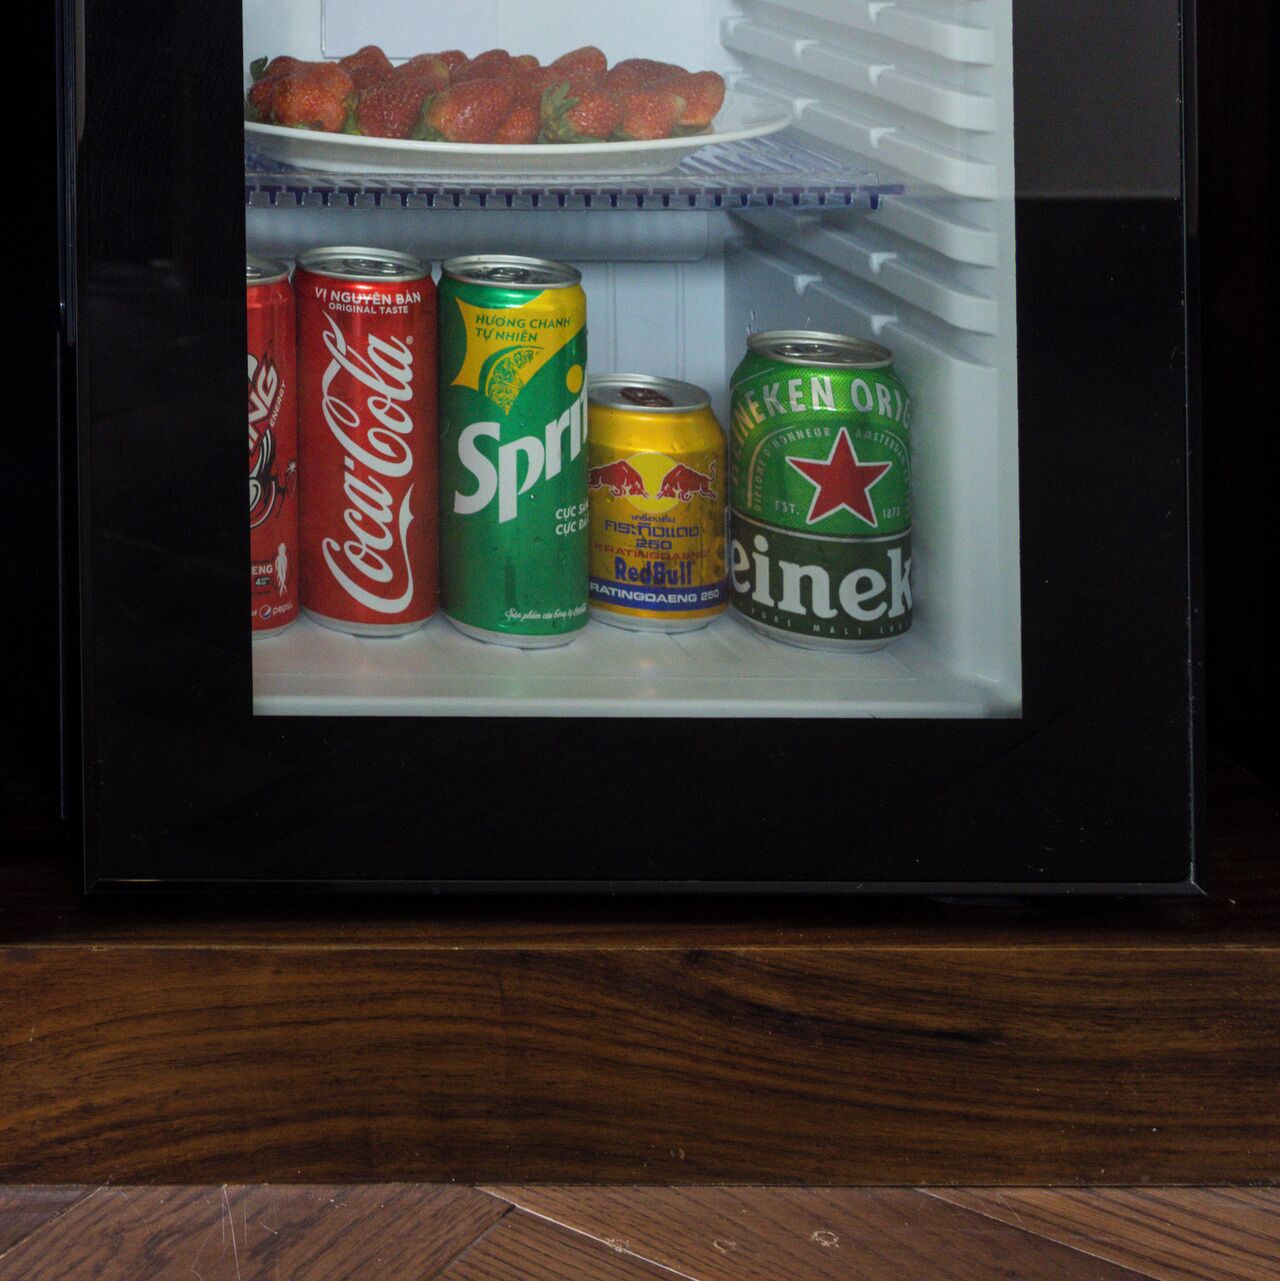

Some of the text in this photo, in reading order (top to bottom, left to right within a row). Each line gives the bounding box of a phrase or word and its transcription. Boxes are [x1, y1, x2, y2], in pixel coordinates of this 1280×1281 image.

[329, 302, 409, 314] ORIGINAL TASTE
[530, 317, 571, 329] CHANH
[322, 310, 414, 613] Coca-Cola
[636, 537, 673, 550] 250
[700, 589, 720, 601] 250
[813, 624, 862, 634] MALT
